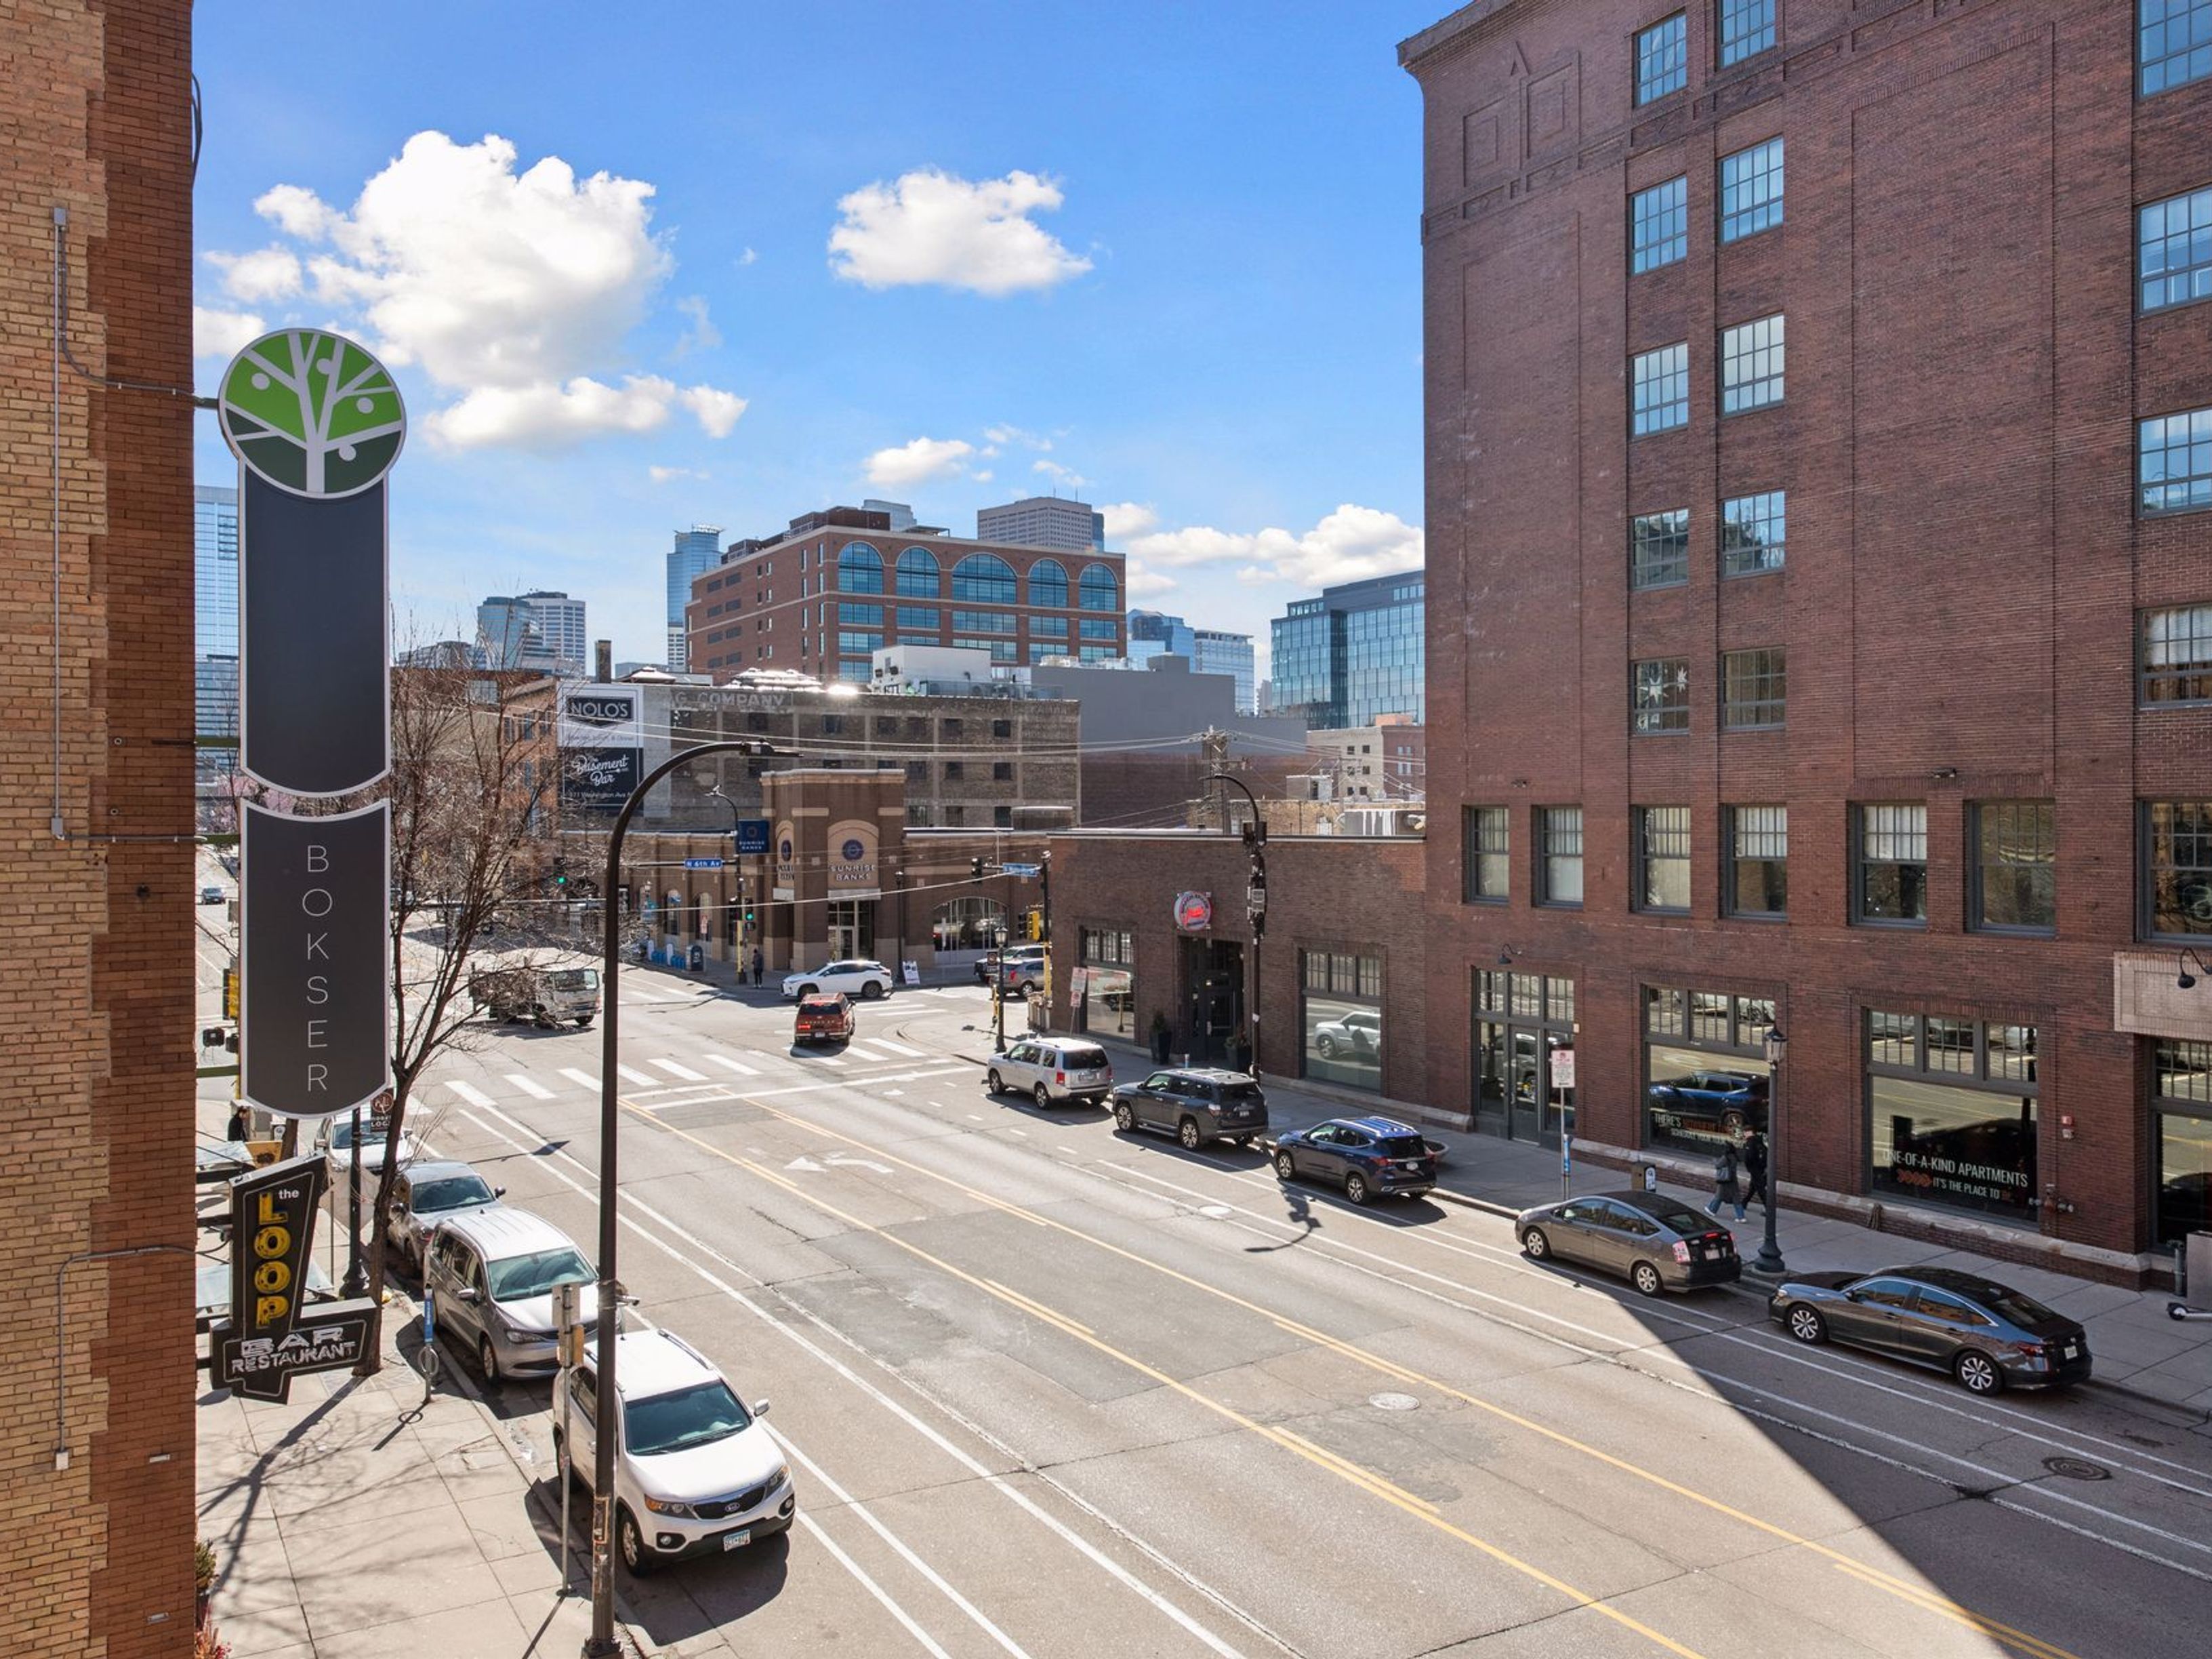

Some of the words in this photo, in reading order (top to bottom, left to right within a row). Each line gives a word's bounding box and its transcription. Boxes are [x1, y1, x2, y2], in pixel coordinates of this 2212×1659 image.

[697, 692, 785, 706] COMPANY
[571, 702, 628, 717] NOLO'S
[570, 754, 630, 774] Basement
[590, 771, 615, 786] Bar
[830, 864, 876, 872] SUNRISE
[836, 873, 872, 881] BANKS
[302, 844, 333, 1092] BOKSER
[1883, 1149, 1956, 1173] ONE-OF-A-KIND
[1957, 1162, 2028, 1187] APARTMENTS
[279, 1189, 300, 1200] the
[1932, 1177, 1947, 1189] IT'S
[1948, 1181, 1963, 1193] THE
[1964, 1183, 1988, 1197] PLACE
[1990, 1188, 2000, 1200] TO
[253, 1191, 291, 1330] LOOP
[241, 1327, 344, 1359] BAR
[231, 1341, 356, 1374] RESTAURANT
